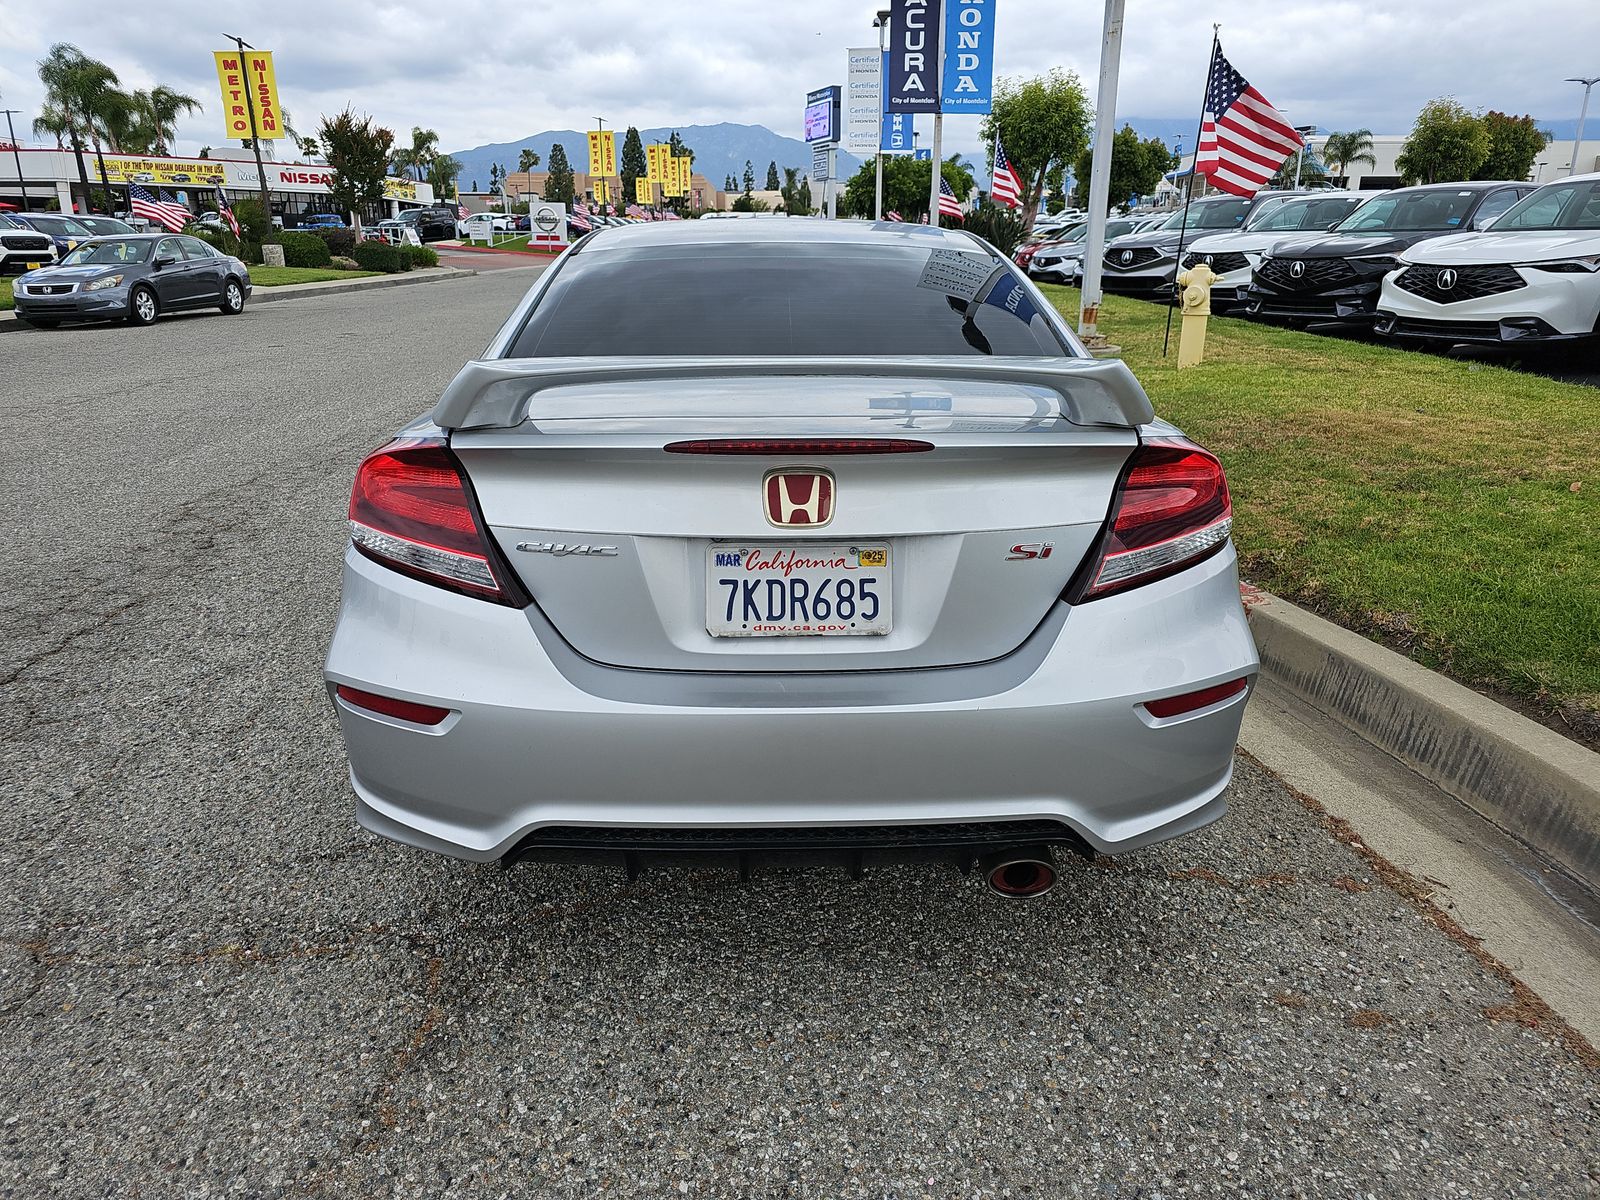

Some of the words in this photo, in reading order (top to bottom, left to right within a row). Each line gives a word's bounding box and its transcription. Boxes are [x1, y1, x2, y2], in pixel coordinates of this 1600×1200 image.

[954, 0, 984, 92] ONDA
[222, 60, 246, 130] METRO
[253, 60, 276, 130] NISSAN
[591, 135, 599, 172] METRO
[155, 164, 173, 172] NISSAN
[175, 164, 195, 173] DEALERS
[215, 166, 224, 174] USA
[238, 172, 272, 182] Meo
[516, 541, 619, 557] CIVIC
[1004, 541, 1056, 561] Si
[716, 554, 741, 566] MAR
[746, 550, 858, 577] California
[872, 551, 883, 559] 25
[718, 578, 879, 621] 7KDR685
[753, 624, 846, 632] dmv.ca.gov
